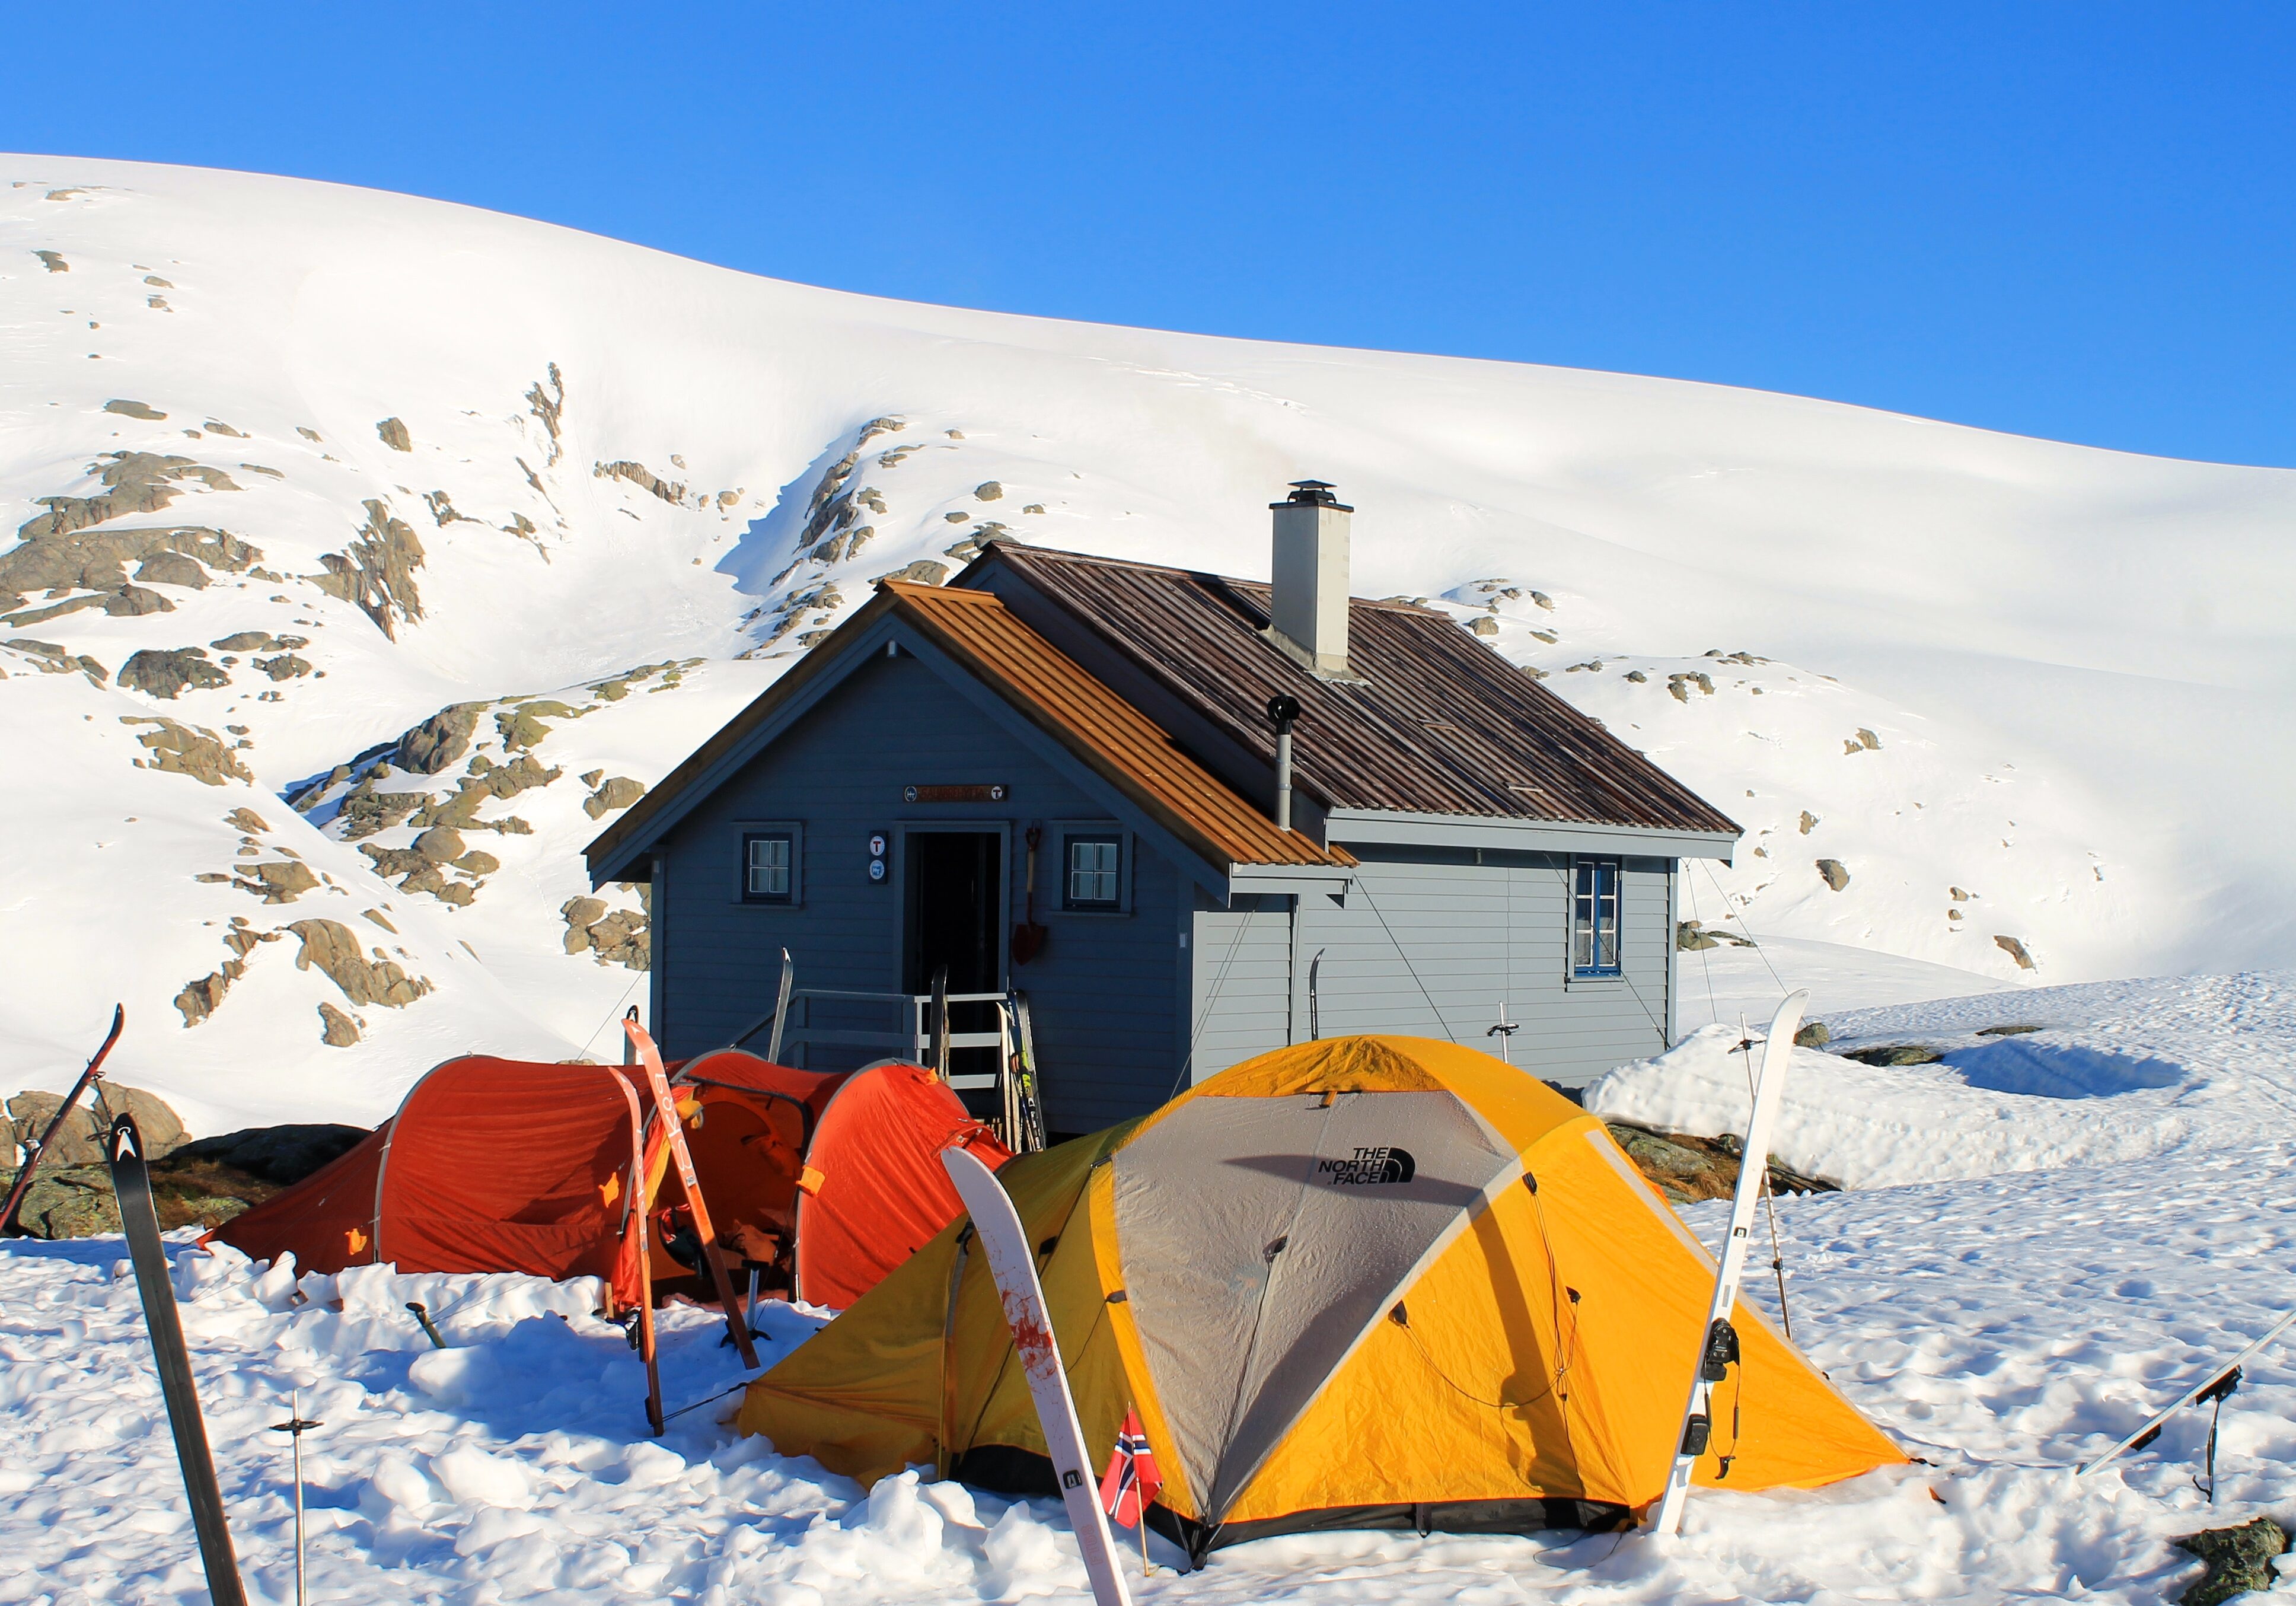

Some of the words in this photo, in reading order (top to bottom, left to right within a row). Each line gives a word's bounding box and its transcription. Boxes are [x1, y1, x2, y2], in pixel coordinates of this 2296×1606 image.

[873, 841, 881, 852] T
[1353, 1147, 1389, 1159] THE
[1318, 1159, 1385, 1172] NORTH
[1332, 1171, 1380, 1185] FACE
